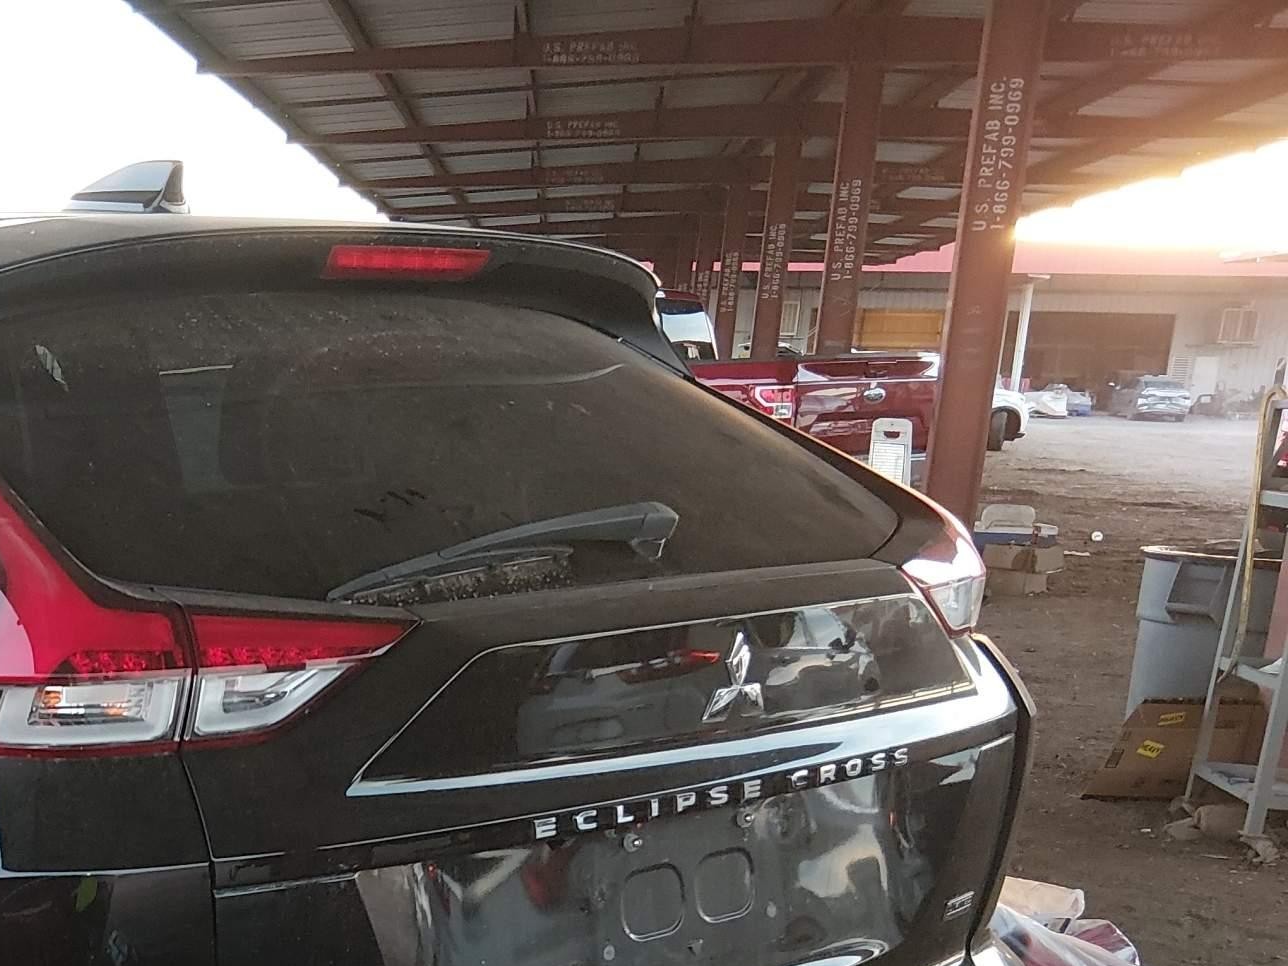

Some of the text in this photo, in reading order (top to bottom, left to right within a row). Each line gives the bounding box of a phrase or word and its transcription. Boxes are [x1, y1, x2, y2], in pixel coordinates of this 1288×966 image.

[988, 76, 1007, 111] INC.
[978, 119, 1001, 189] PREFAB
[990, 77, 1025, 231] 1-866-799-0969
[834, 207, 849, 253] PREFAB
[533, 747, 910, 840] ECLIPSE CROSS
